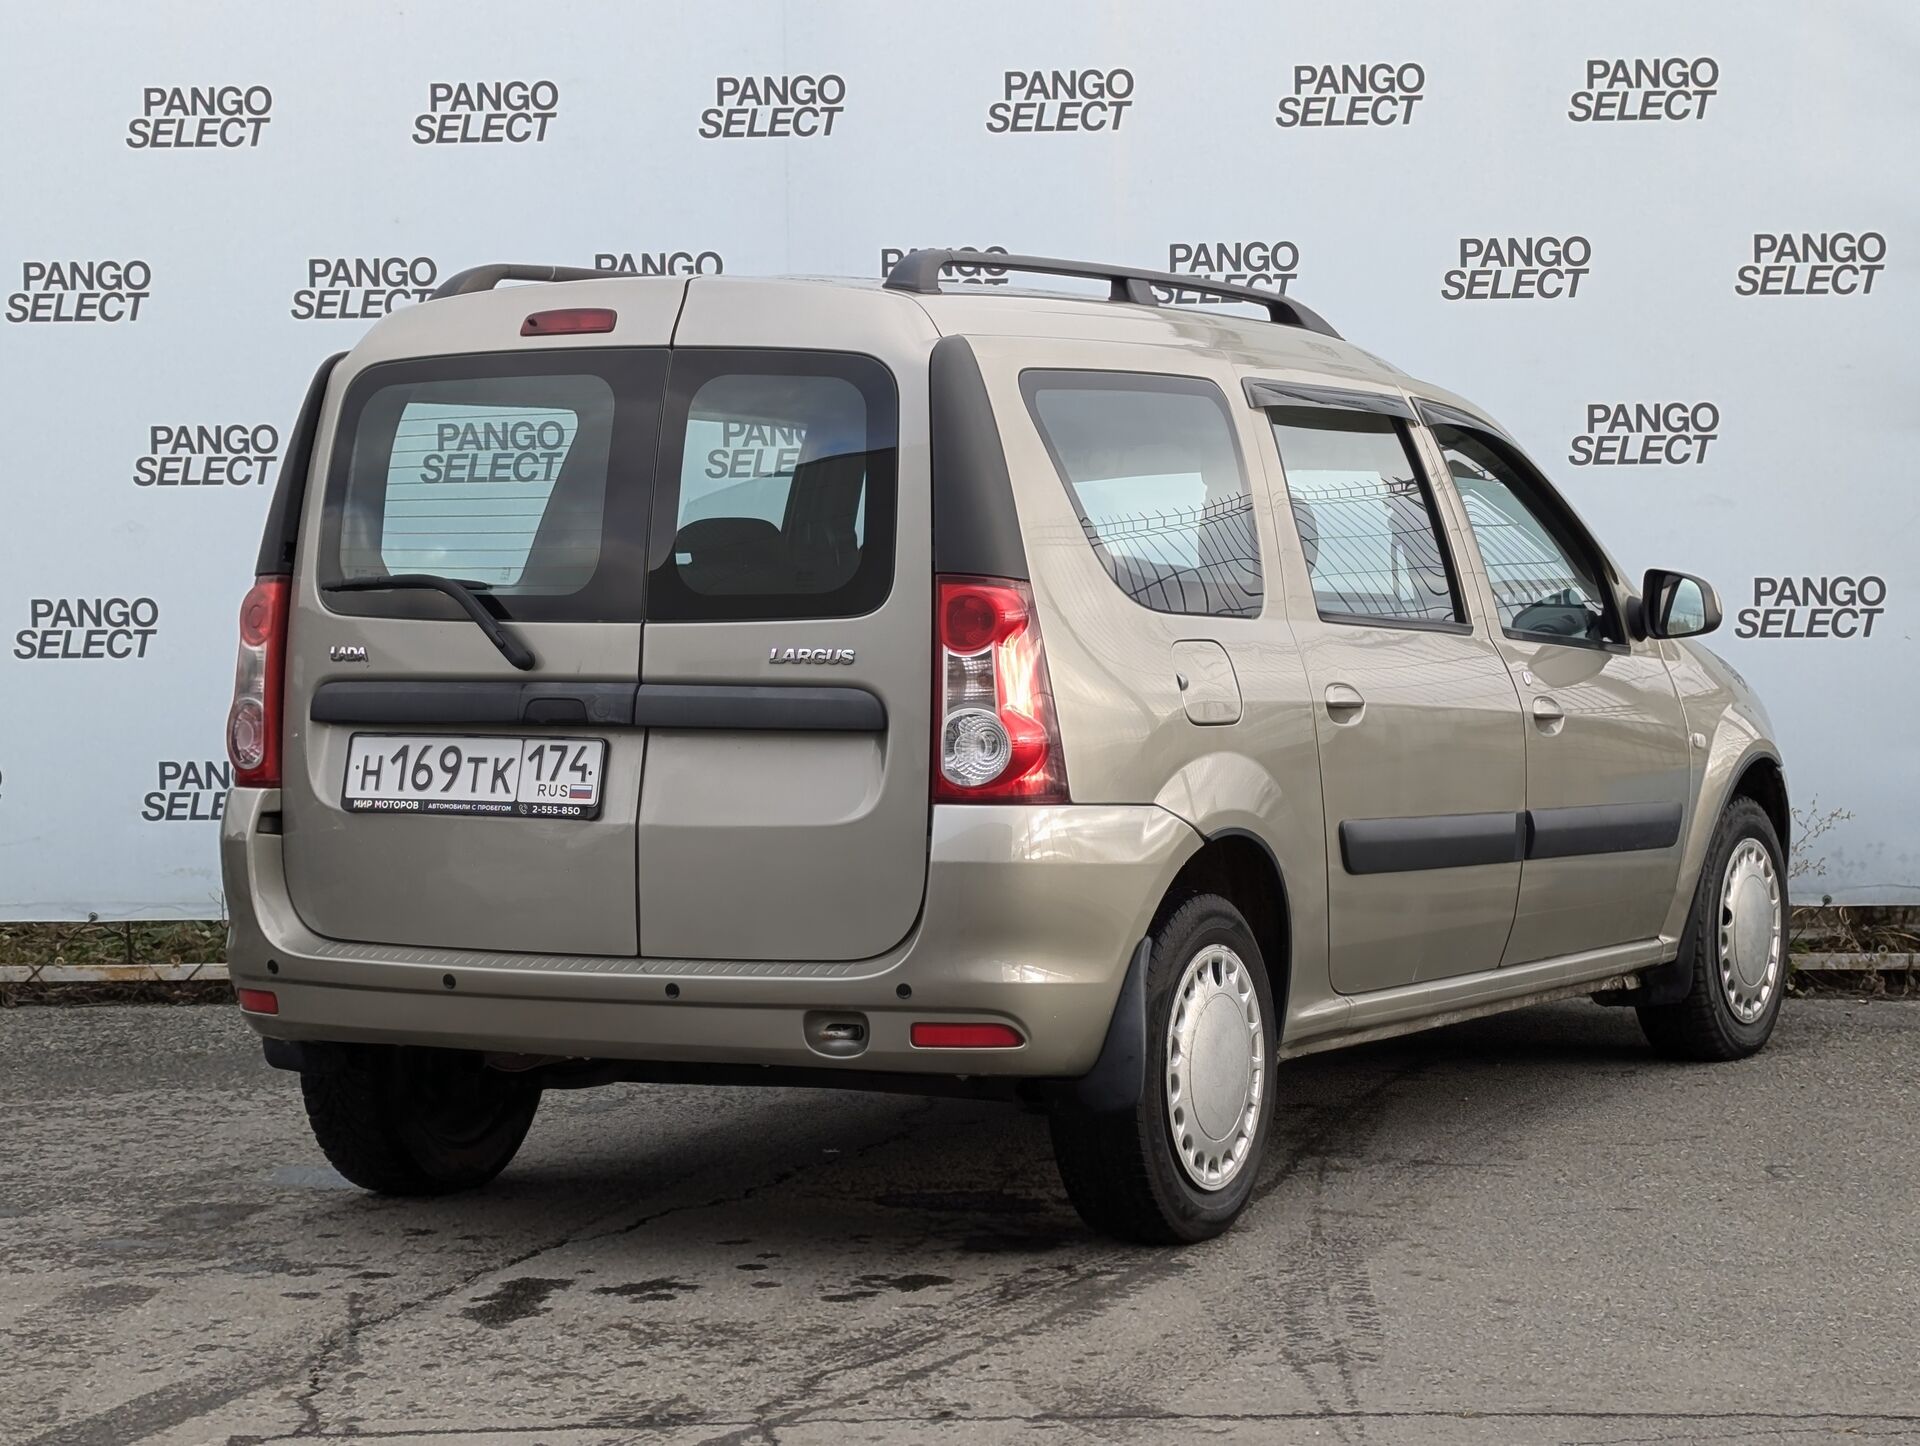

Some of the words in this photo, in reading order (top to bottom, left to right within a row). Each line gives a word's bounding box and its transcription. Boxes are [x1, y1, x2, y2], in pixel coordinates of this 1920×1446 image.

[1005, 69, 1133, 100] PANGO
[1295, 63, 1424, 94] PANGO
[1587, 58, 1718, 89] PANGO
[145, 86, 271, 116] PANGO
[431, 81, 558, 112] PANGO
[717, 75, 845, 106] PANGO
[1569, 90, 1717, 121] SELECT
[699, 107, 844, 138] SELECT
[987, 101, 1132, 132] SELECT
[1276, 95, 1423, 127] SELECT
[126, 118, 270, 148] SELECT
[413, 112, 557, 144] SELECT
[1169, 241, 1299, 273] PANGO
[1461, 236, 1591, 267] PANGO
[1754, 233, 1886, 263] PANGO
[24, 261, 151, 291] PANGO
[308, 257, 437, 287] PANGO
[1442, 269, 1589, 300] SELECT
[1735, 265, 1884, 295] SELECT
[6, 292, 149, 322] SELECT
[1588, 403, 1719, 433] PANGO
[151, 425, 278, 454] PANGO
[437, 421, 564, 451] PANGO
[723, 421, 807, 448] PAN
[705, 449, 800, 478] SELE
[1569, 435, 1717, 465] SELECT
[133, 456, 277, 486] SELECT
[420, 452, 563, 483] SELECT
[1754, 576, 1886, 606] PANGO
[31, 598, 158, 628] PANGO
[1735, 608, 1884, 638] SELECT
[14, 629, 157, 659] SELECT
[330, 646, 369, 662] LADA
[769, 648, 856, 665] LARGUS
[158, 761, 235, 791] PAN
[527, 744, 588, 783] 174
[353, 800, 373, 809] МИР
[374, 801, 420, 810] МОТОРОВ
[537, 784, 568, 797] RUS
[141, 792, 226, 821] SELE
[427, 803, 471, 811] АВТОМОБИЛИ
[478, 804, 512, 812] ПРОБЕГОМ
[532, 805, 581, 815] 2-555-850
